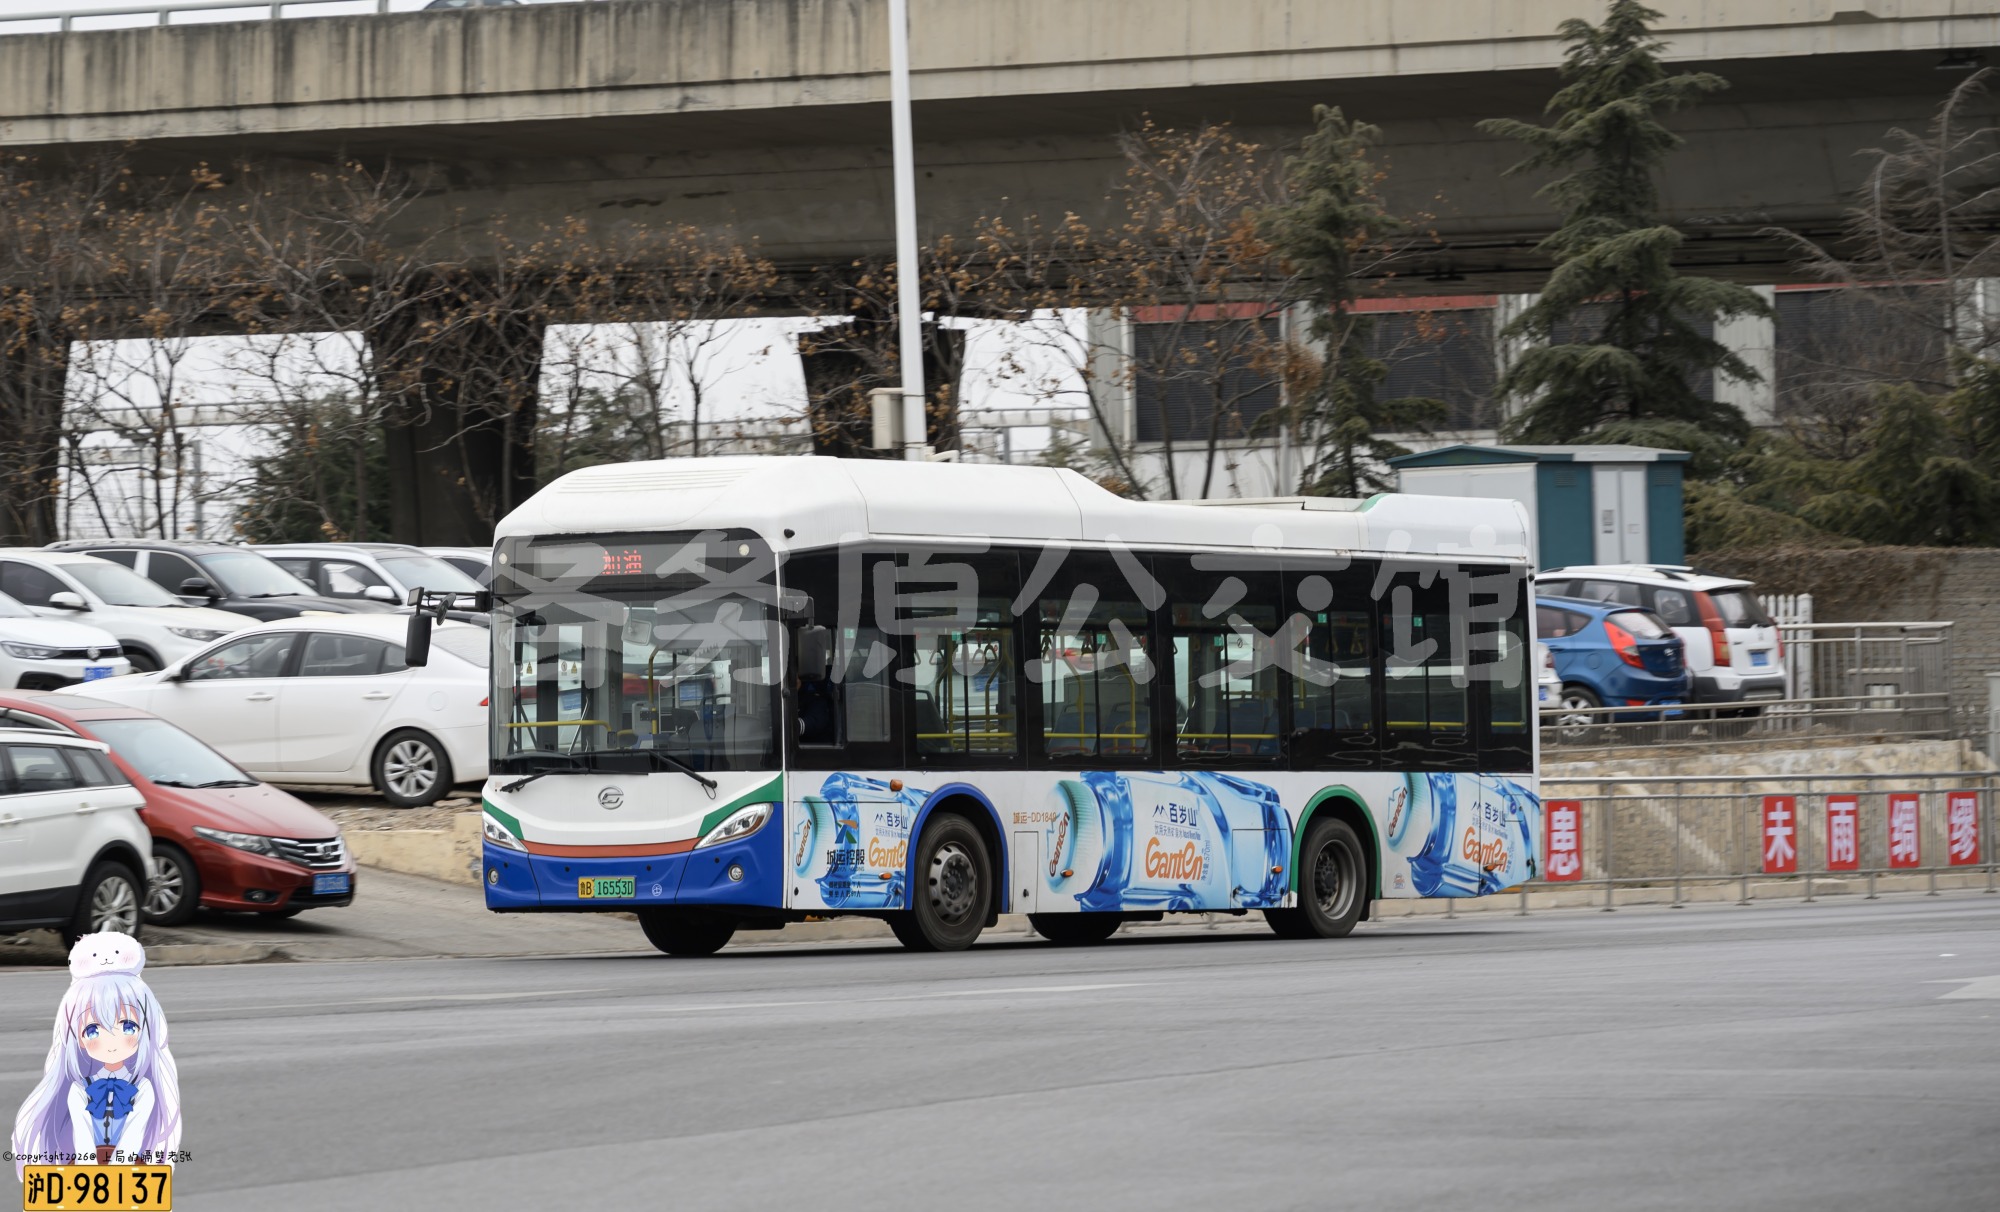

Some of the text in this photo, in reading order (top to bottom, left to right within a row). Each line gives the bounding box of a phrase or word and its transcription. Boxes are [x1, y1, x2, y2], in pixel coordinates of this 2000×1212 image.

[1168, 802, 1198, 827] 百岁山
[1548, 806, 1580, 876] 患
[1765, 801, 1795, 869] 未
[1829, 801, 1857, 864] 雨
[1891, 799, 1919, 863] 绸
[826, 848, 865, 866] 城运控股
[868, 836, 907, 869] Gante
[1145, 836, 1203, 881] Ganten
